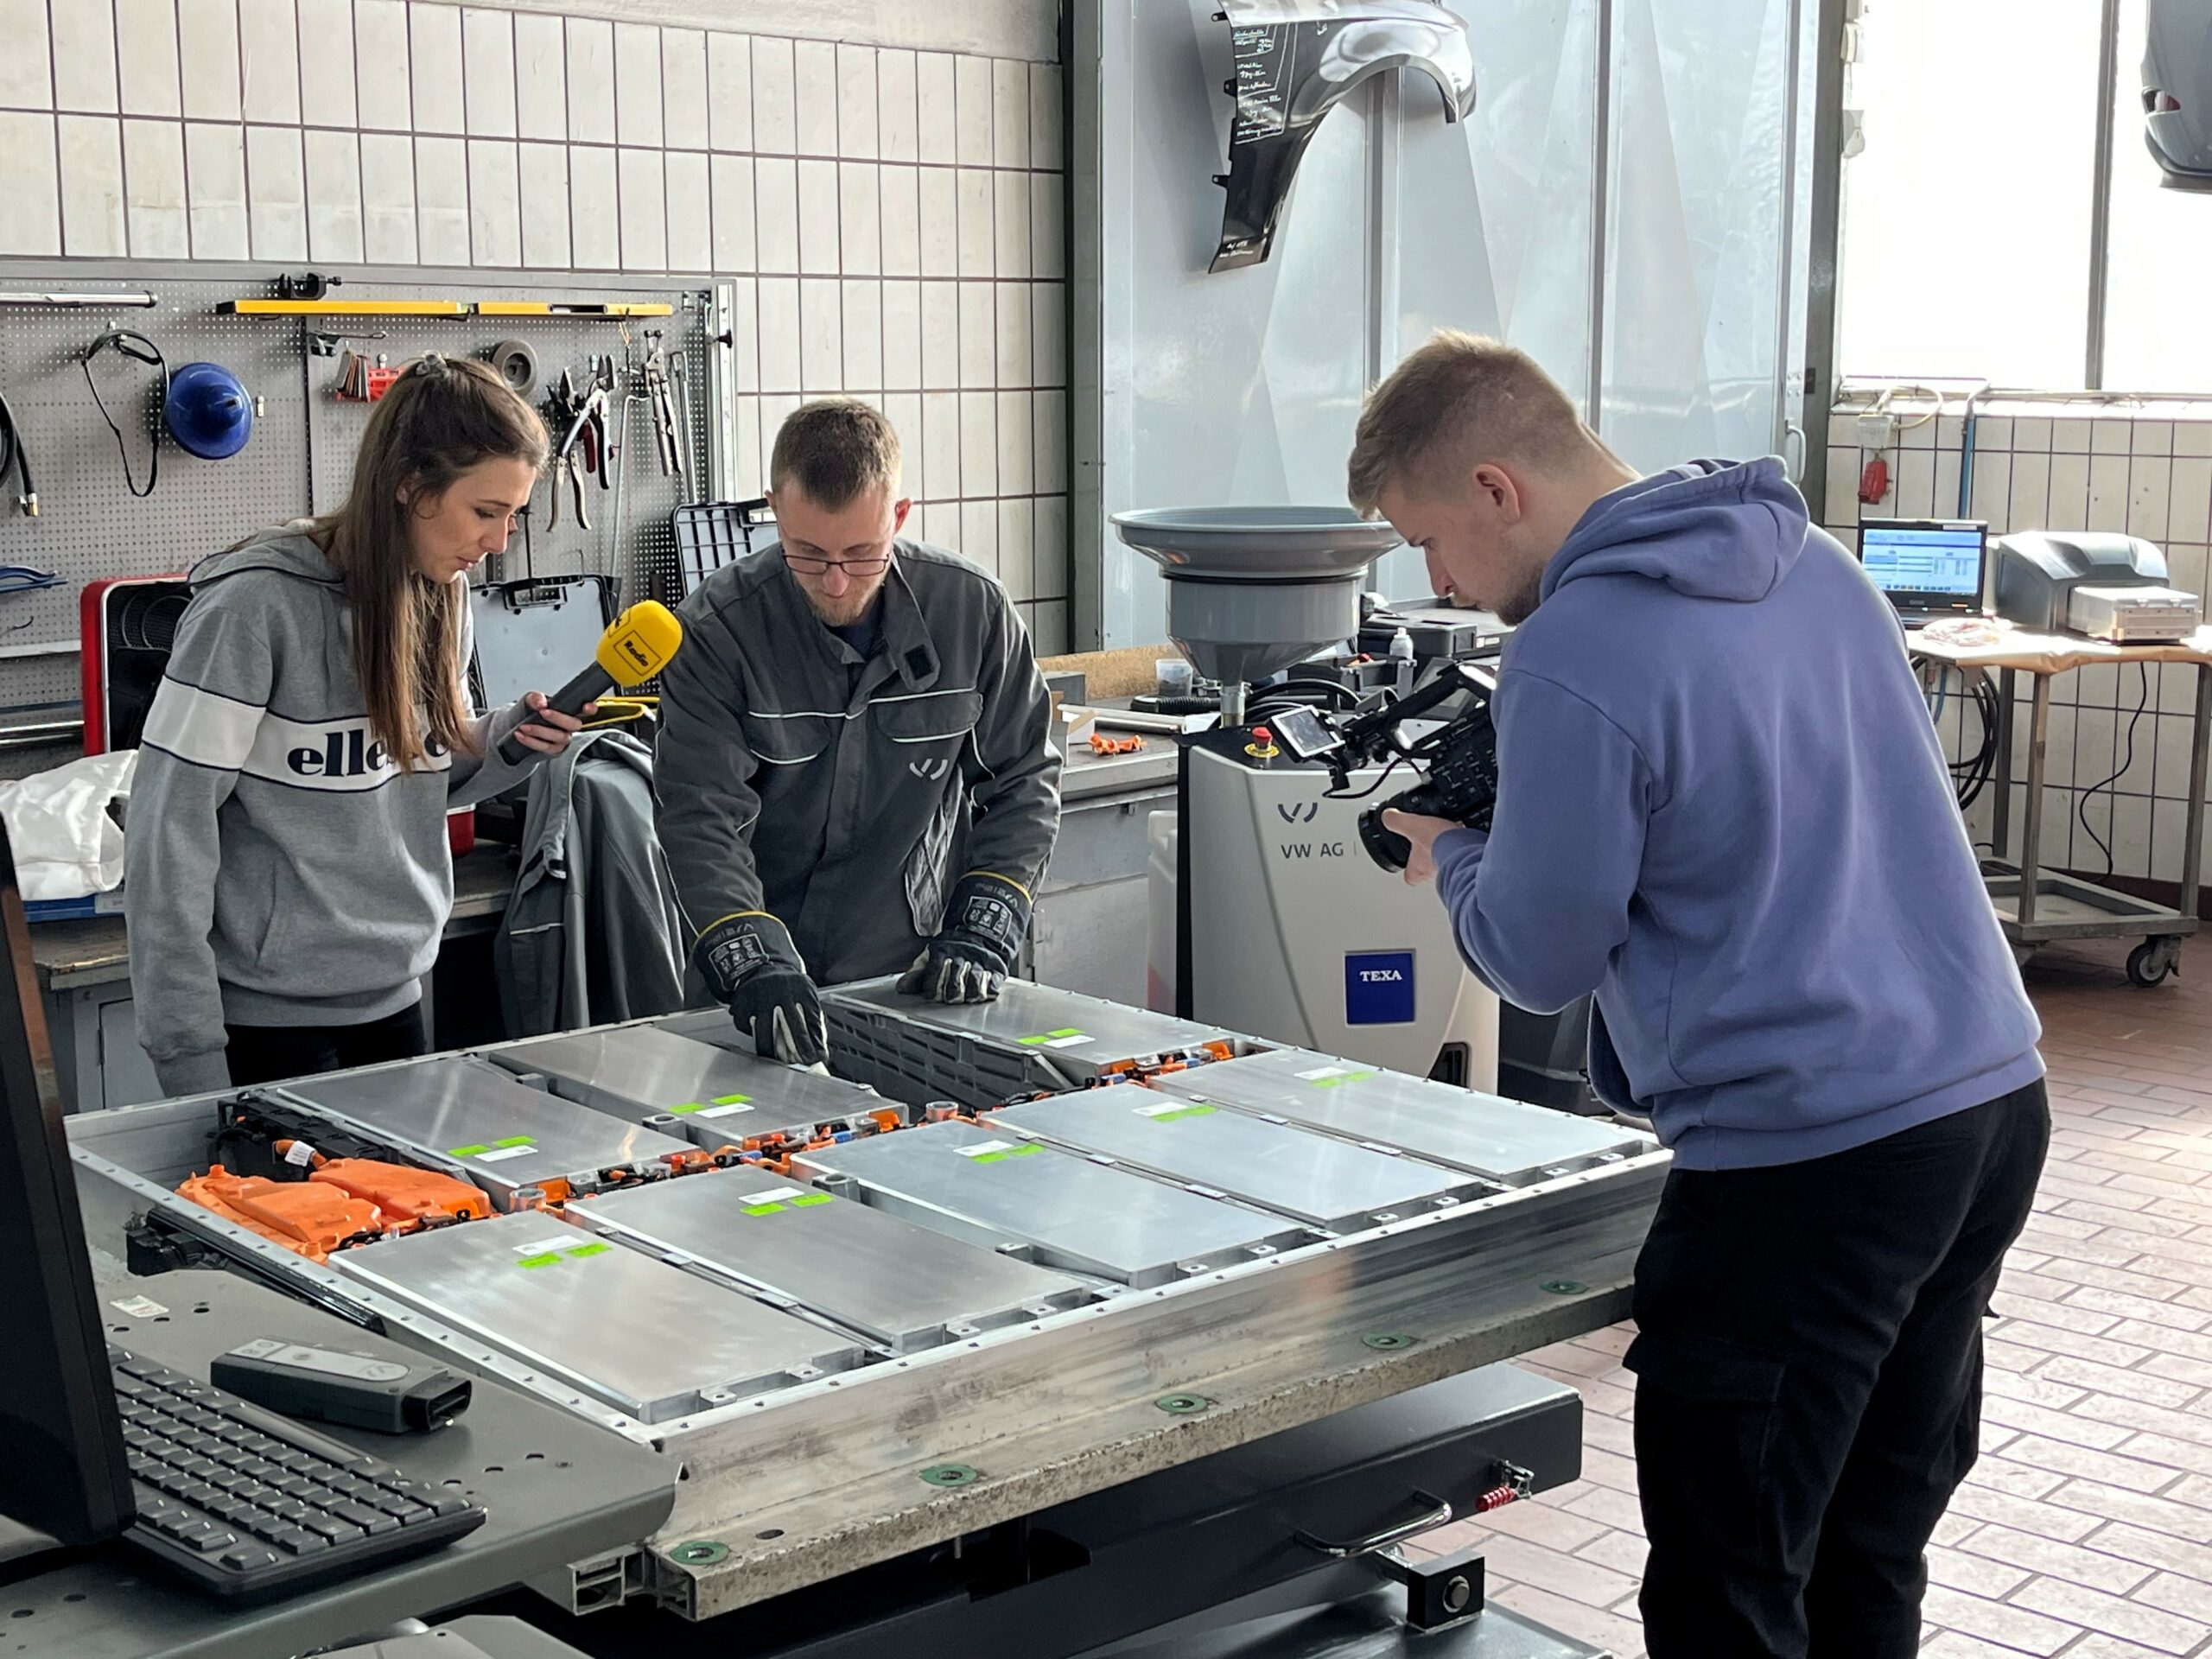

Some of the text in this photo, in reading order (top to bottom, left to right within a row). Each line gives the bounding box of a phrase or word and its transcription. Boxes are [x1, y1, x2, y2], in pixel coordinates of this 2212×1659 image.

[624, 640, 649, 667] Radio
[1281, 842, 1344, 859] VW AG
[1359, 969, 1402, 982] TEXA
